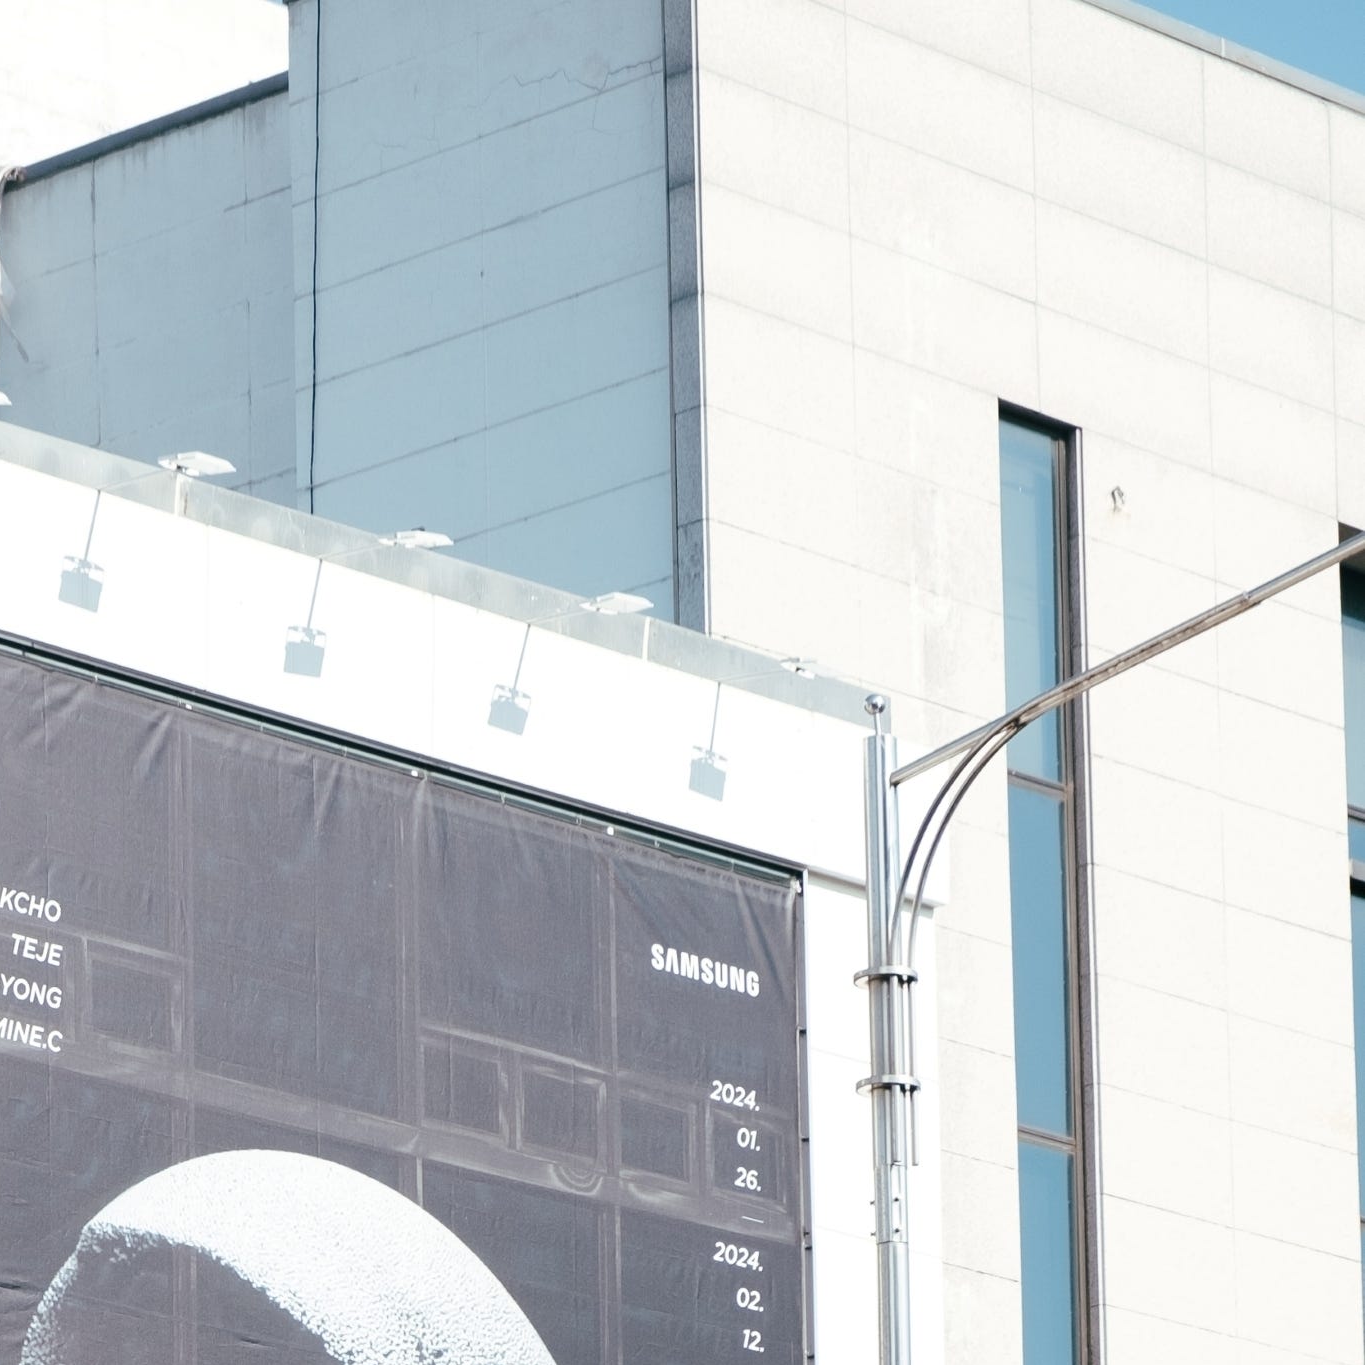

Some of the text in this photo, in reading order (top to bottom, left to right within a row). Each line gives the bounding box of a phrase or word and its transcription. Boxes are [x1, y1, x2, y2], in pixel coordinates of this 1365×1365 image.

[11, 933, 63, 967] TEJE
[650, 943, 760, 998] SAMSUNG
[709, 1080, 760, 1112] 2024.
[736, 1127, 761, 1152] 01.
[734, 1166, 762, 1192] 26.
[712, 1241, 764, 1272] 2024.
[736, 1287, 764, 1313] 02.
[743, 1329, 765, 1353] 12.
